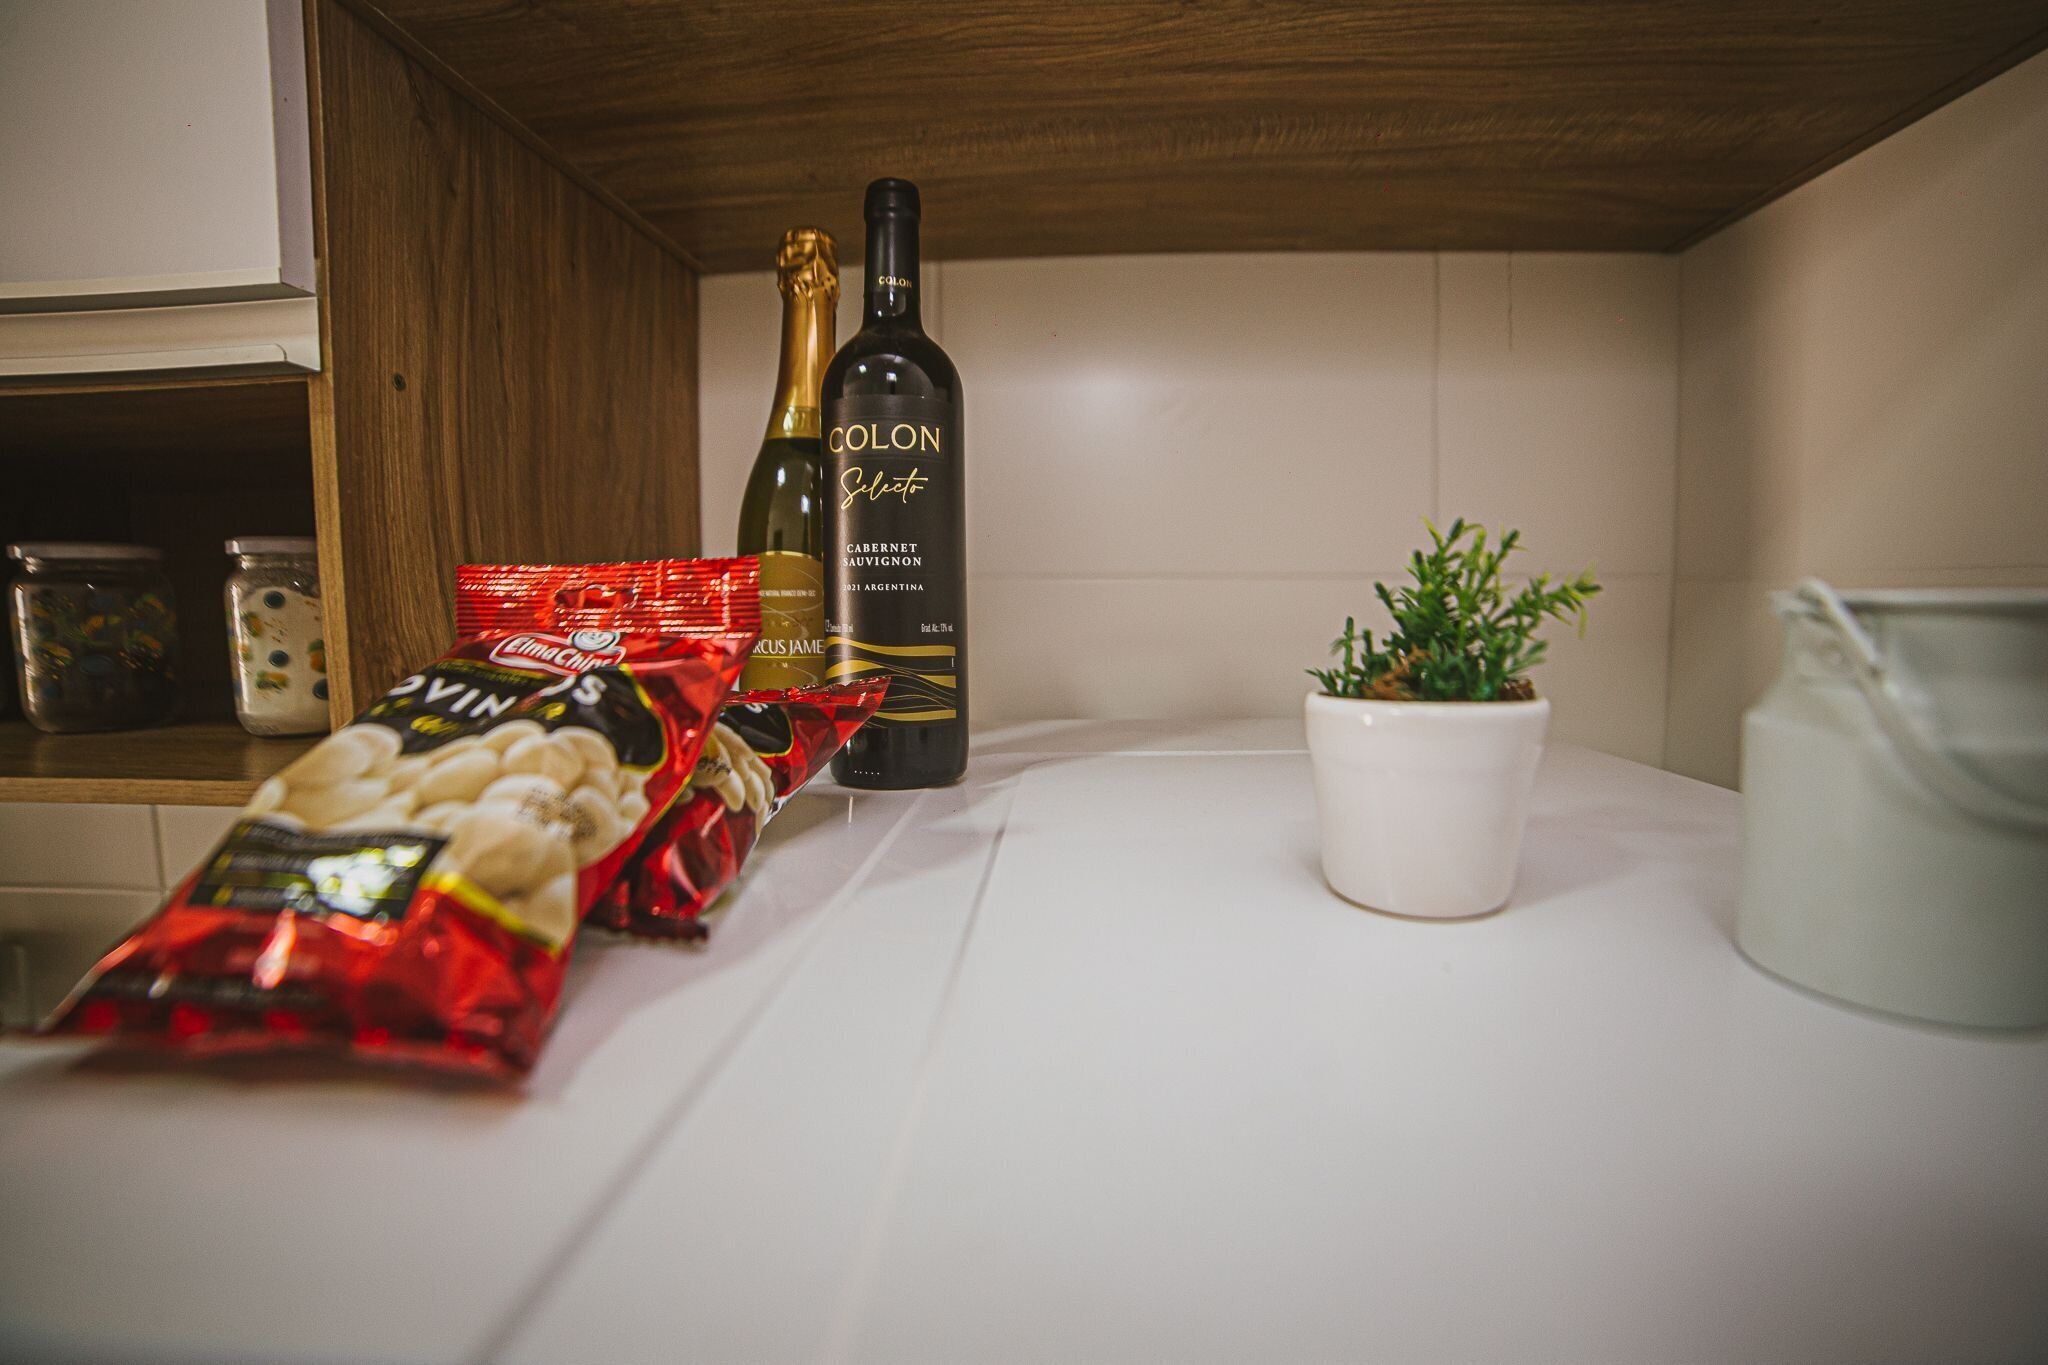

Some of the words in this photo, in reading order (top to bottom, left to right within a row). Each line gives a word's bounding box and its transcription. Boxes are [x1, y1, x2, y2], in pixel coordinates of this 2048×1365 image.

[878, 275, 913, 289] COLON
[829, 423, 941, 454] COLON
[840, 466, 929, 510] Selecto
[846, 543, 918, 554] CABERNET
[842, 556, 922, 567] SAUVIGNON
[864, 583, 924, 591] ARGENTINA
